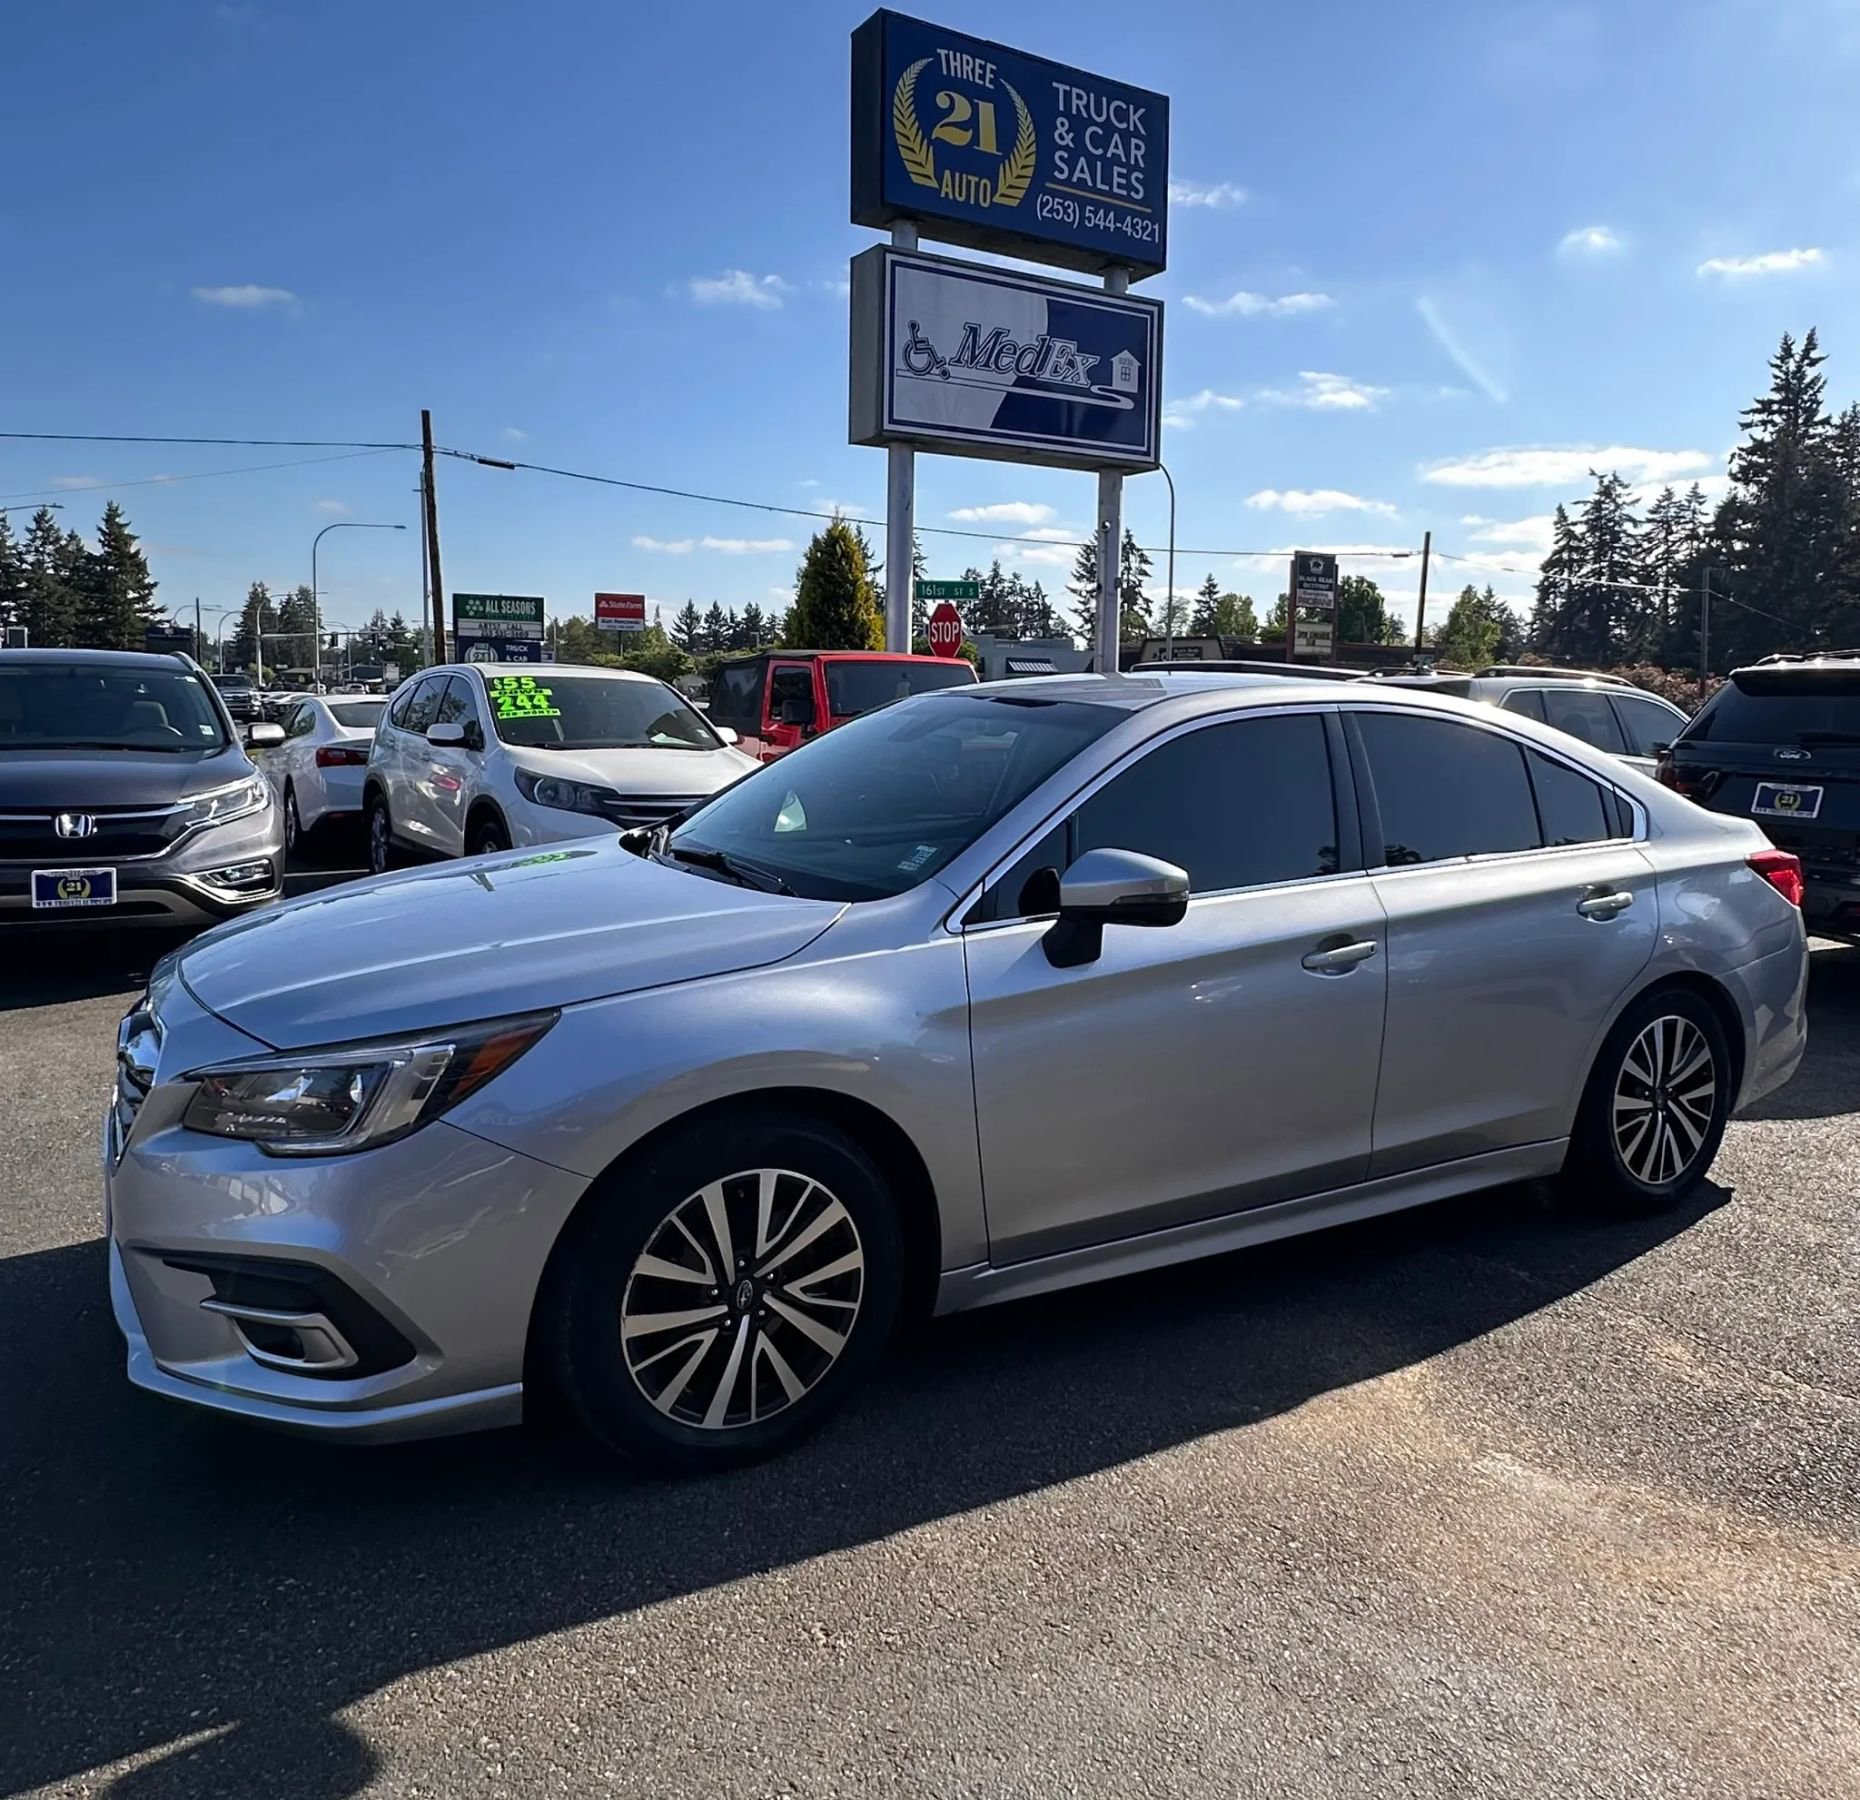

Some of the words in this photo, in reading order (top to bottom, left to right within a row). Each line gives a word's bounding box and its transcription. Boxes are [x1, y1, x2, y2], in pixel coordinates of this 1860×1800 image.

[937, 48, 997, 90] THREE
[931, 91, 1003, 155] 21
[1052, 81, 1147, 136] TRUCK
[1054, 117, 1075, 149] &
[1084, 126, 1146, 168] CAR
[940, 169, 992, 208] AUTO
[1053, 150, 1145, 200] SALES
[1036, 193, 1080, 229] (253)
[1084, 205, 1160, 243] 544-4321
[950, 321, 1101, 389] MedEx
[485, 600, 499, 613] ALL
[501, 600, 536, 615] SEASONS
[505, 644, 528, 652] TRUCK
[931, 621, 959, 643] STOP
[497, 694, 549, 710] 244
[1781, 795, 1794, 804] 21
[66, 882, 82, 891] 21
